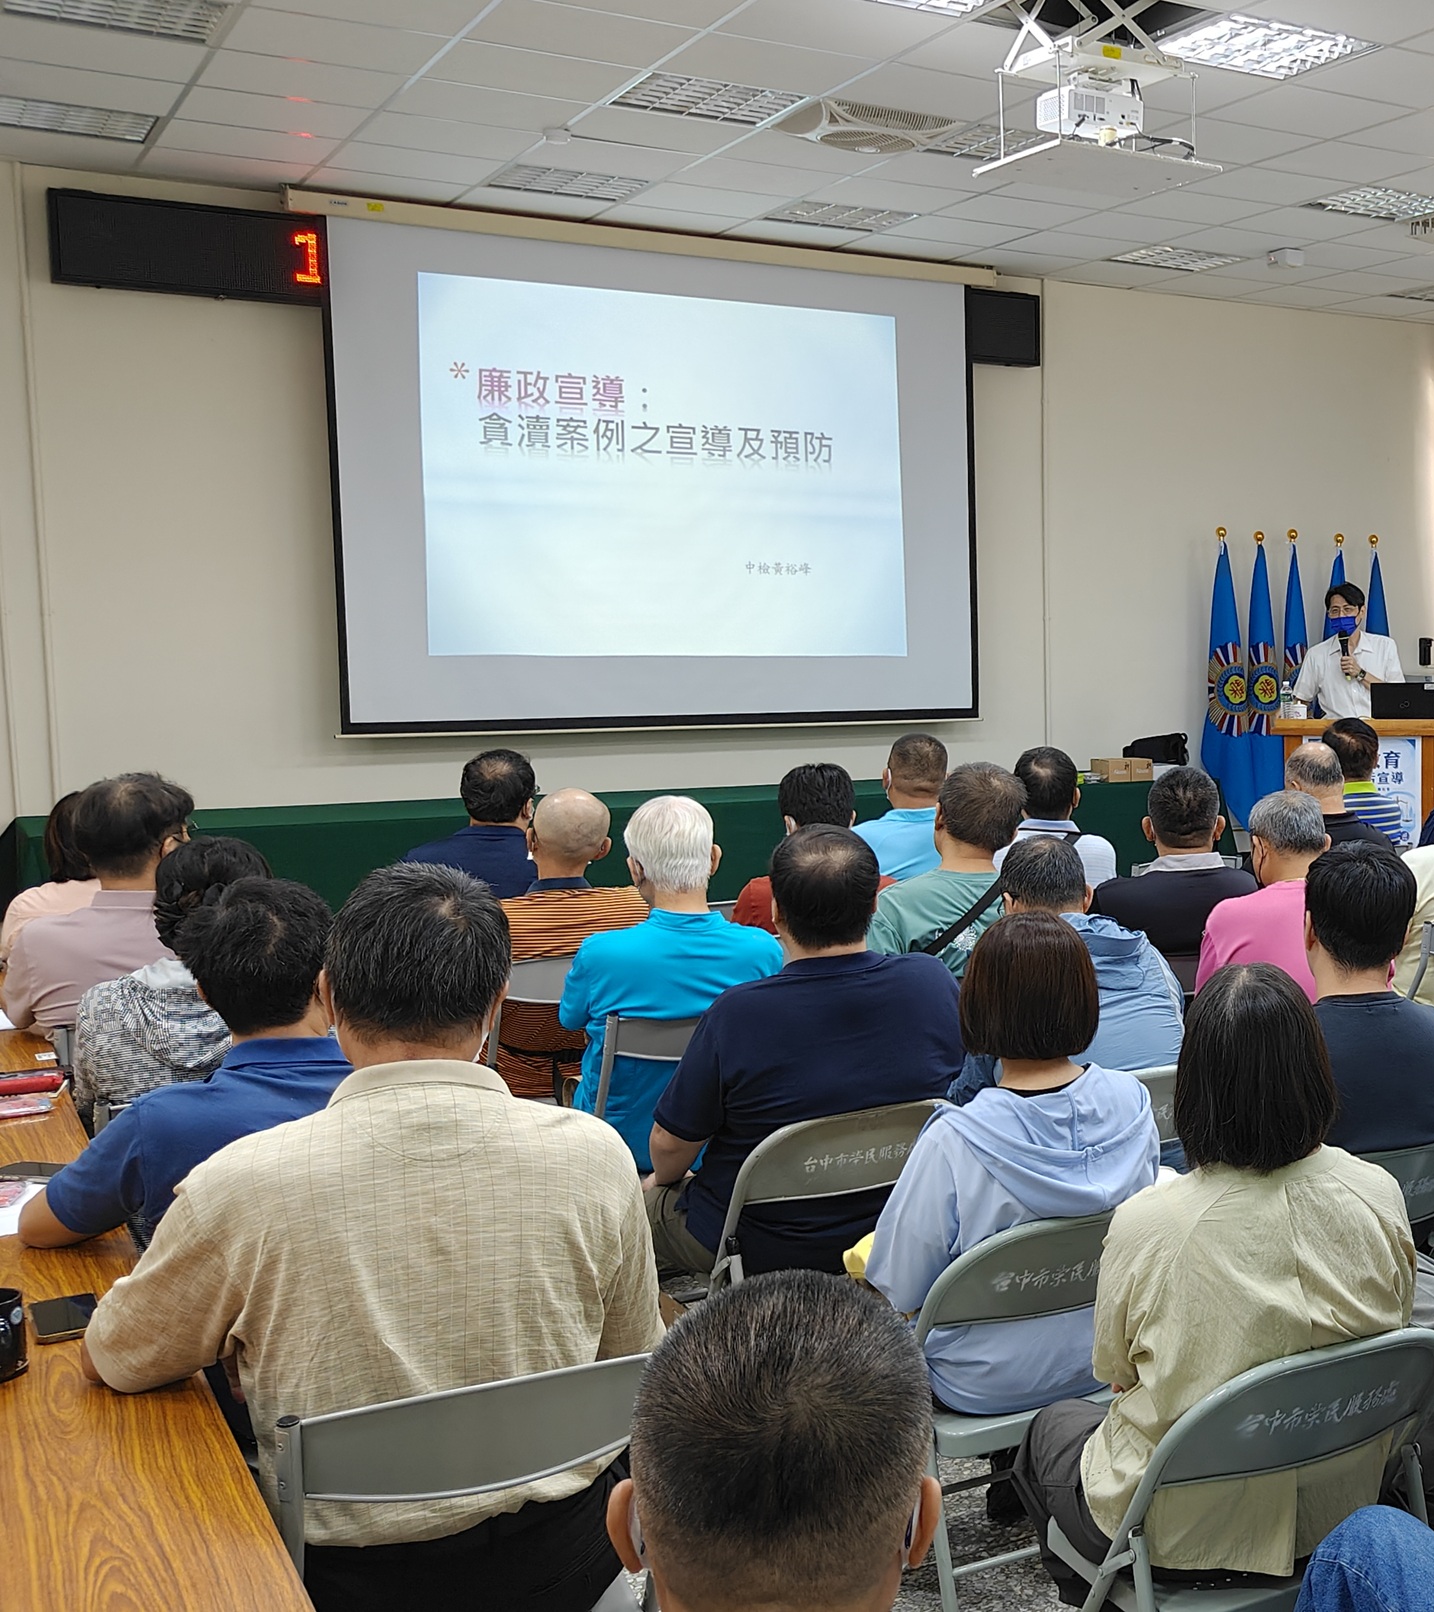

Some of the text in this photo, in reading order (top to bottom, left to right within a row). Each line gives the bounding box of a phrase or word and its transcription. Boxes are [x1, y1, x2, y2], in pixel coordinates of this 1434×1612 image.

[294, 232, 321, 284] 1
[477, 411, 833, 464] 貪瀆案例之宣導及預防
